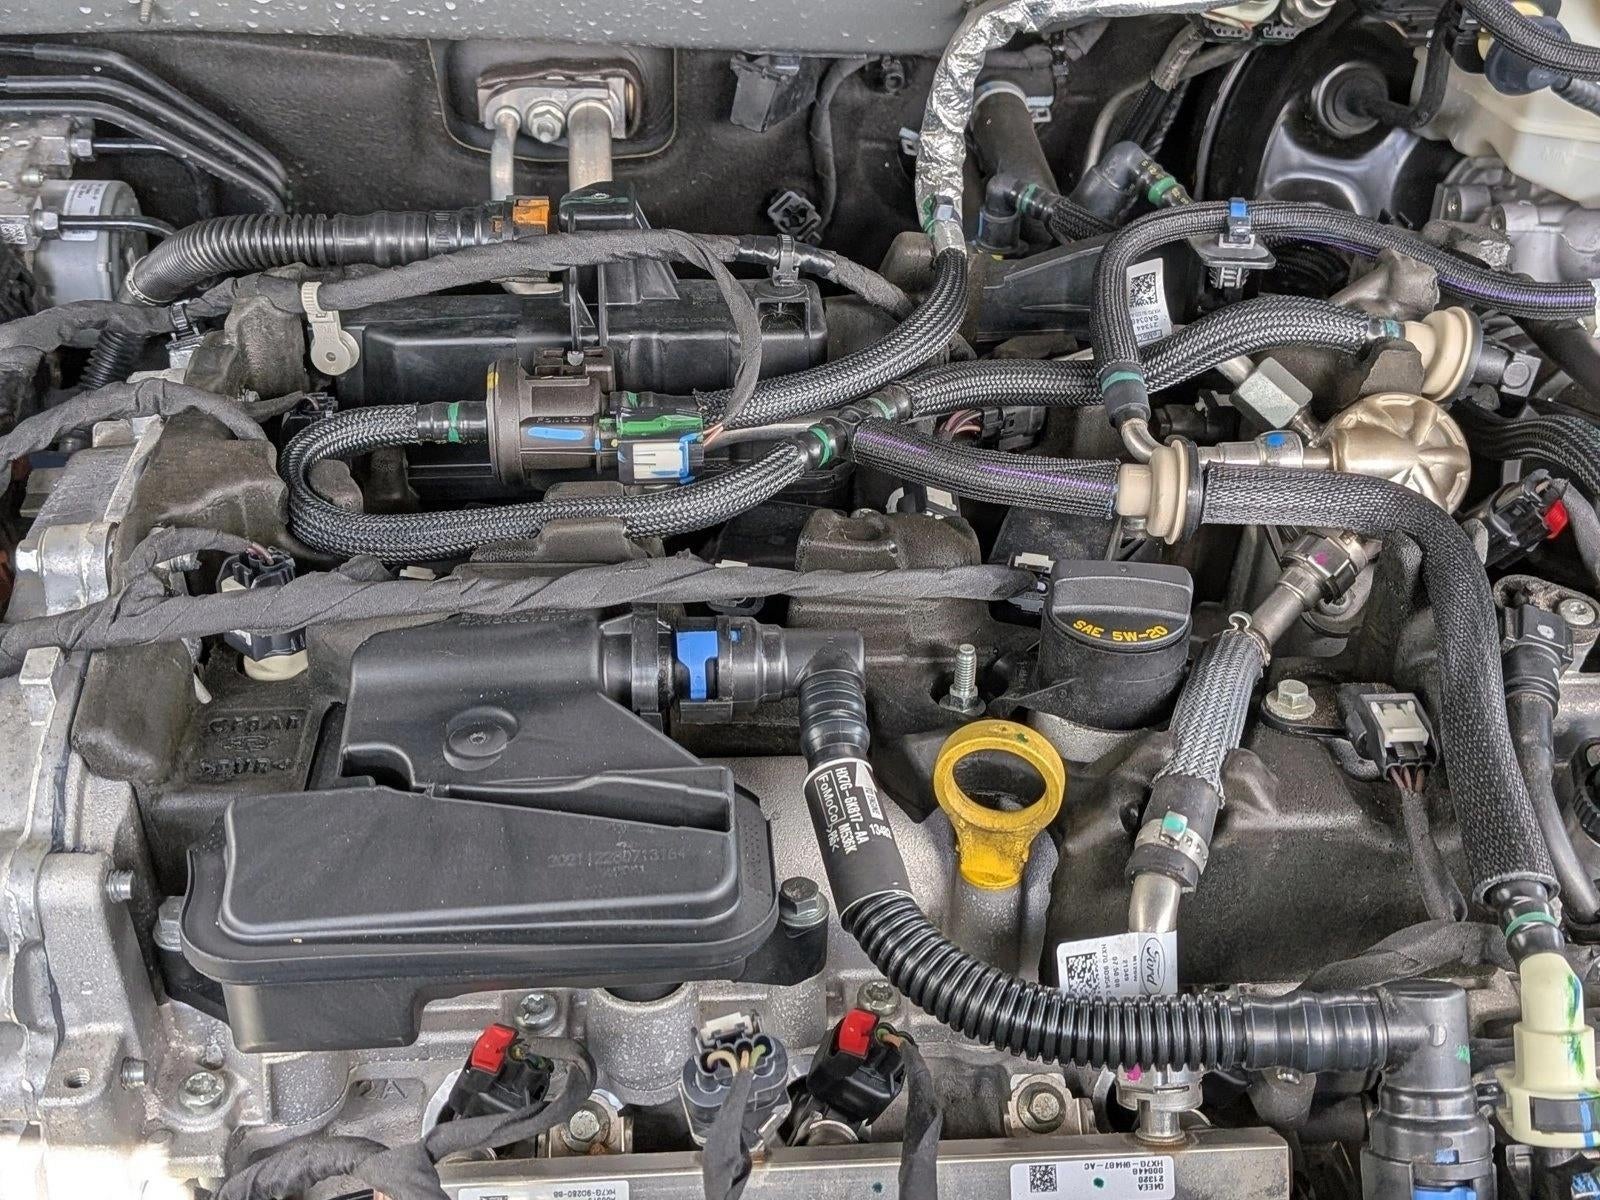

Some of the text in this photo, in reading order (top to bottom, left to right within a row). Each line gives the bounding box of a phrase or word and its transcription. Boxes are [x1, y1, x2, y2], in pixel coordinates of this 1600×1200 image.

[1073, 619, 1169, 642] SAE 5W-20
[818, 775, 838, 822] FoMoCo
[835, 767, 869, 844] HX7G-6K817-AA
[1147, 945, 1160, 987] Ford
